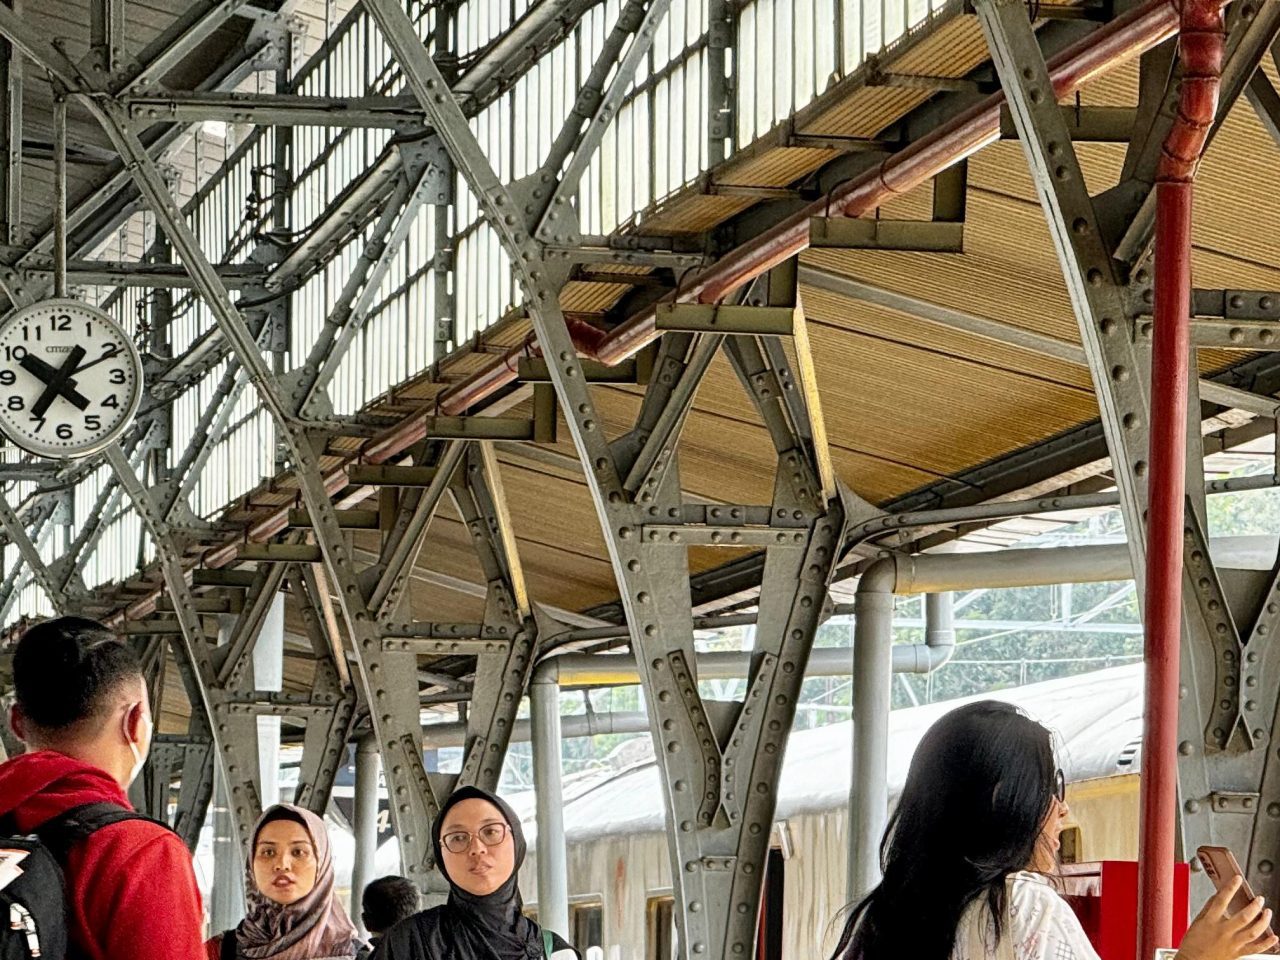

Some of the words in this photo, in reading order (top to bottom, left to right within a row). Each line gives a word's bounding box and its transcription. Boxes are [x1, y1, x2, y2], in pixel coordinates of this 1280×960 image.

[50, 315, 72, 331] 12
[86, 322, 92, 337] 1
[22, 325, 41, 341] 11
[5, 345, 27, 361] 10
[101, 343, 118, 358] 2
[0, 370, 16, 385] 9
[109, 369, 126, 384] 3
[8, 396, 25, 411] 8
[100, 394, 119, 409] 4
[29, 417, 46, 433] 7
[84, 415, 101, 430] 5
[56, 424, 73, 439] 6
